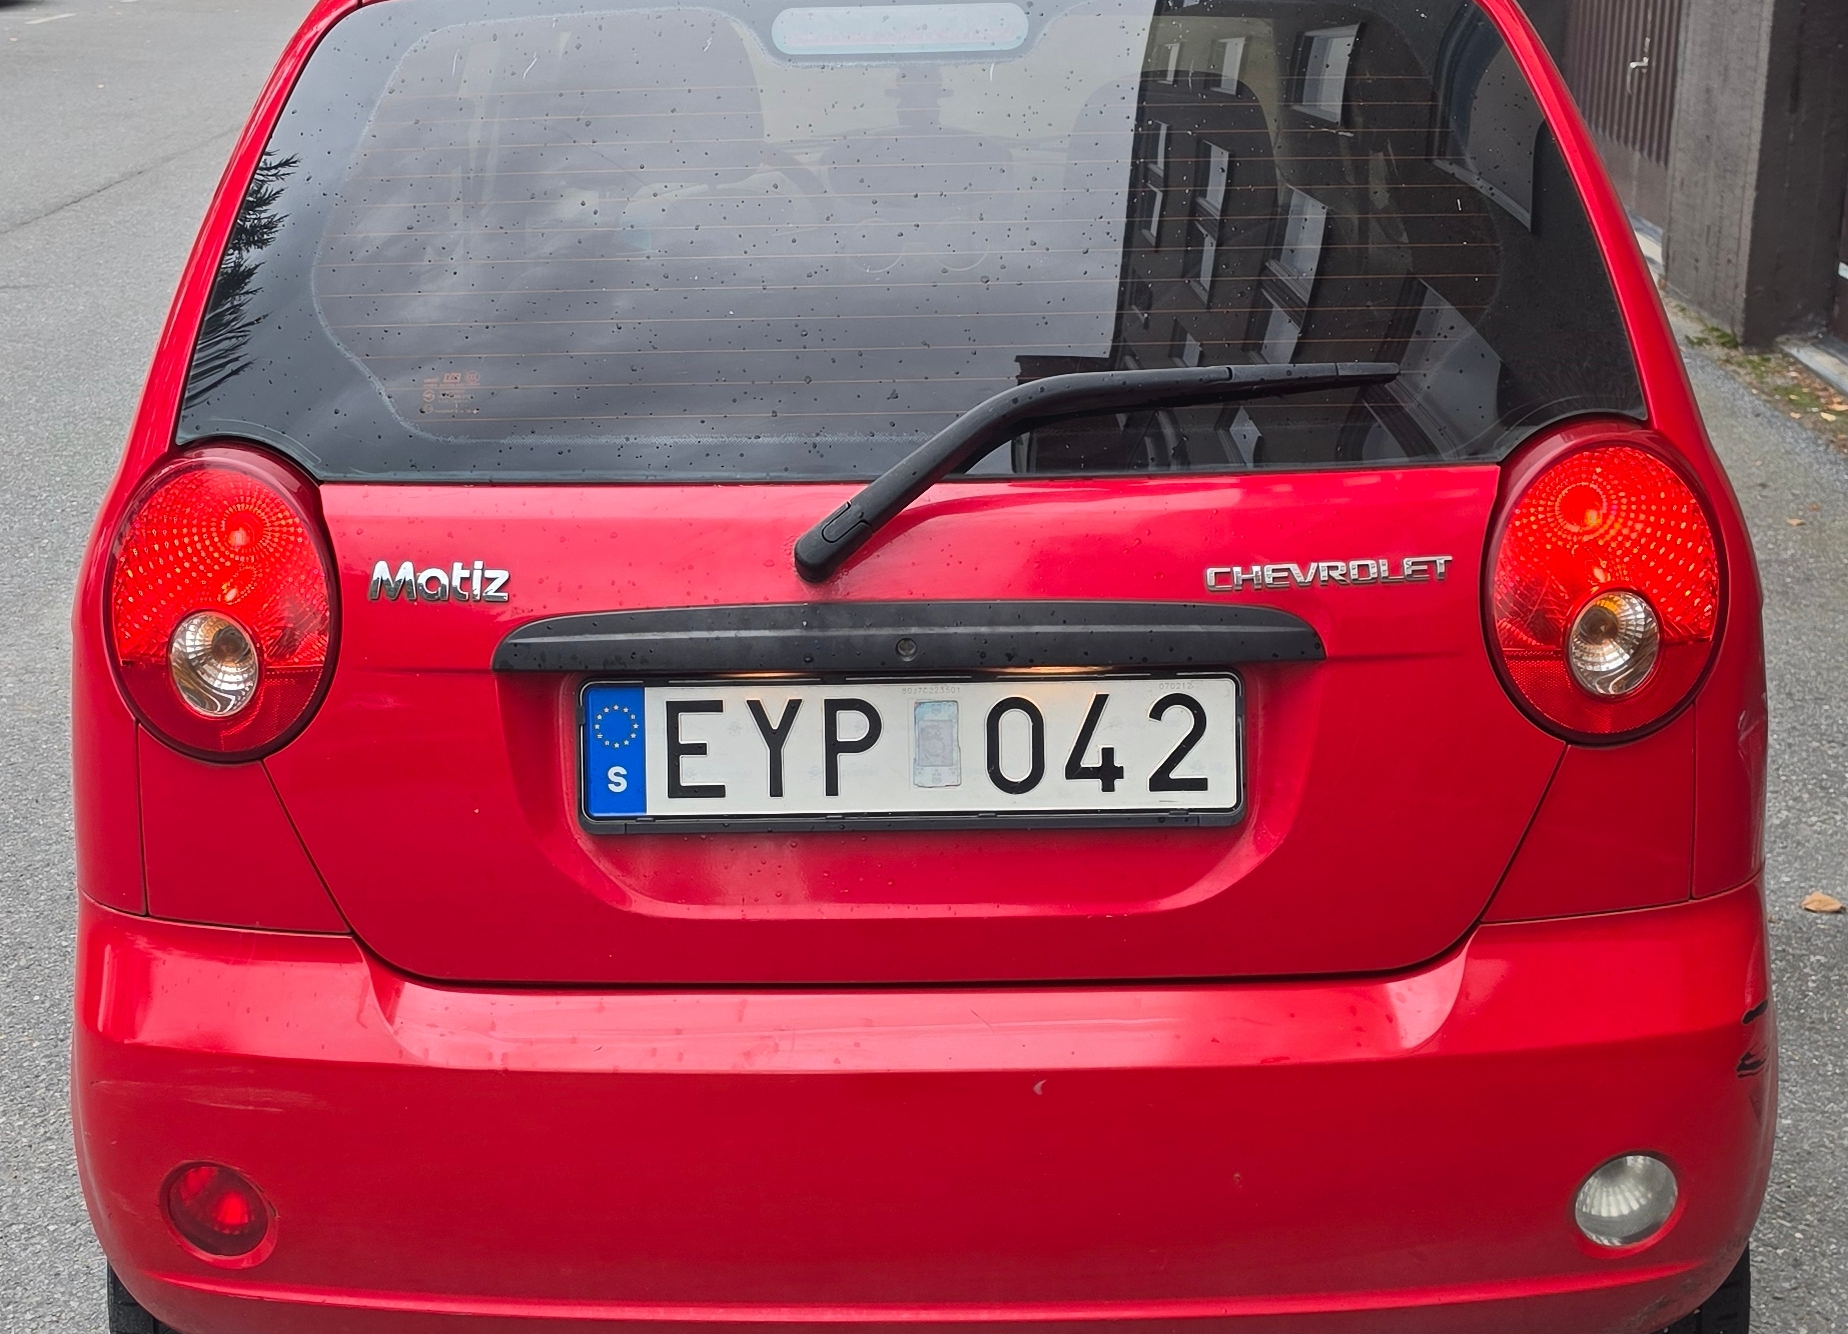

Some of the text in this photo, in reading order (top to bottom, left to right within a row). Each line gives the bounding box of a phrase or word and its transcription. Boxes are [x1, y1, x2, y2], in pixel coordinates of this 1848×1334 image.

[368, 560, 510, 603] Matiz
[1205, 555, 1453, 593] CHEVROLET
[665, 692, 1209, 799] EYP 042
[607, 766, 628, 793] S
